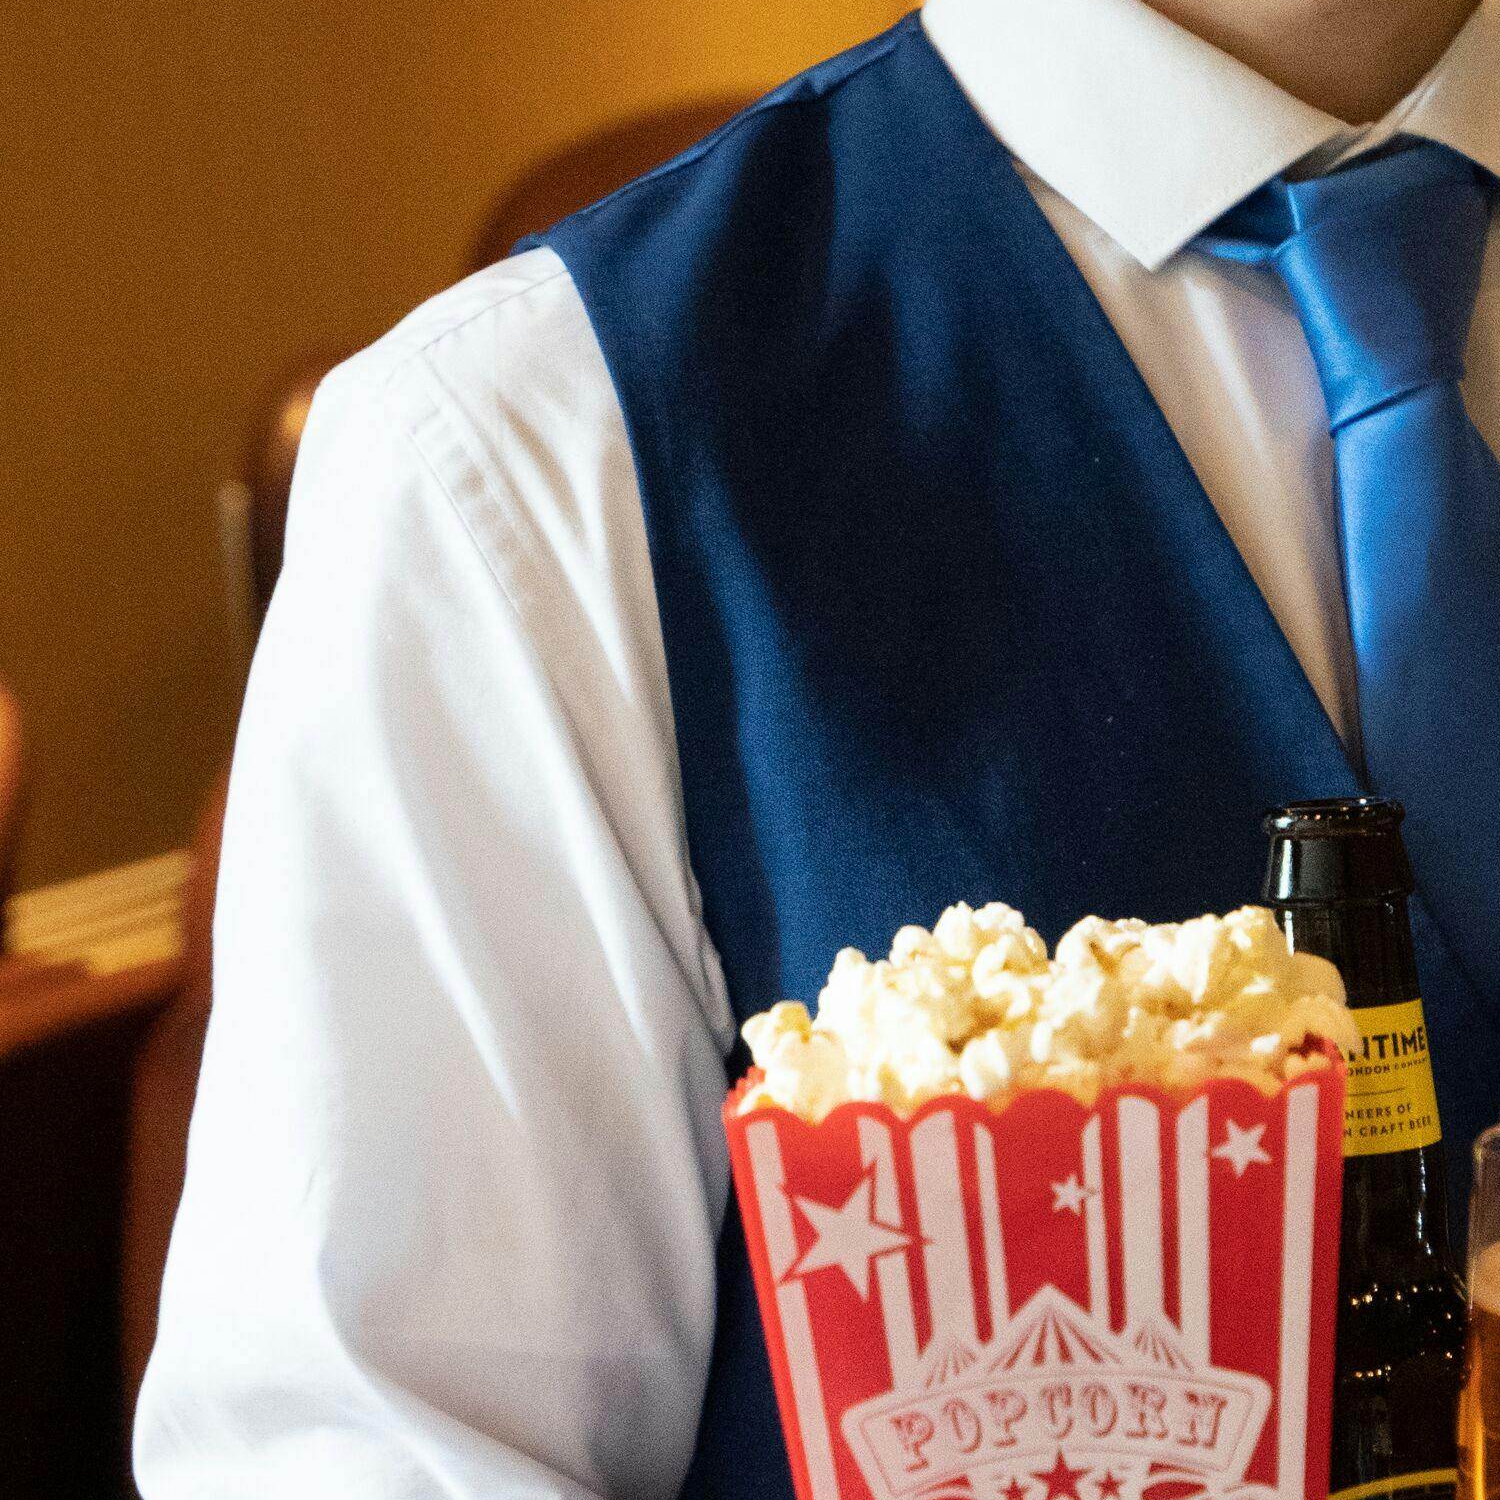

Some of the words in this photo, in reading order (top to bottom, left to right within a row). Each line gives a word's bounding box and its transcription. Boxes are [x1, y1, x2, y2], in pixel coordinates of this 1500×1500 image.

[1344, 1105, 1392, 1120] NEERS
[1396, 1102, 1412, 1115] OF
[1359, 1121, 1404, 1137] CRAFT
[888, 1380, 1230, 1474] POPCORN
